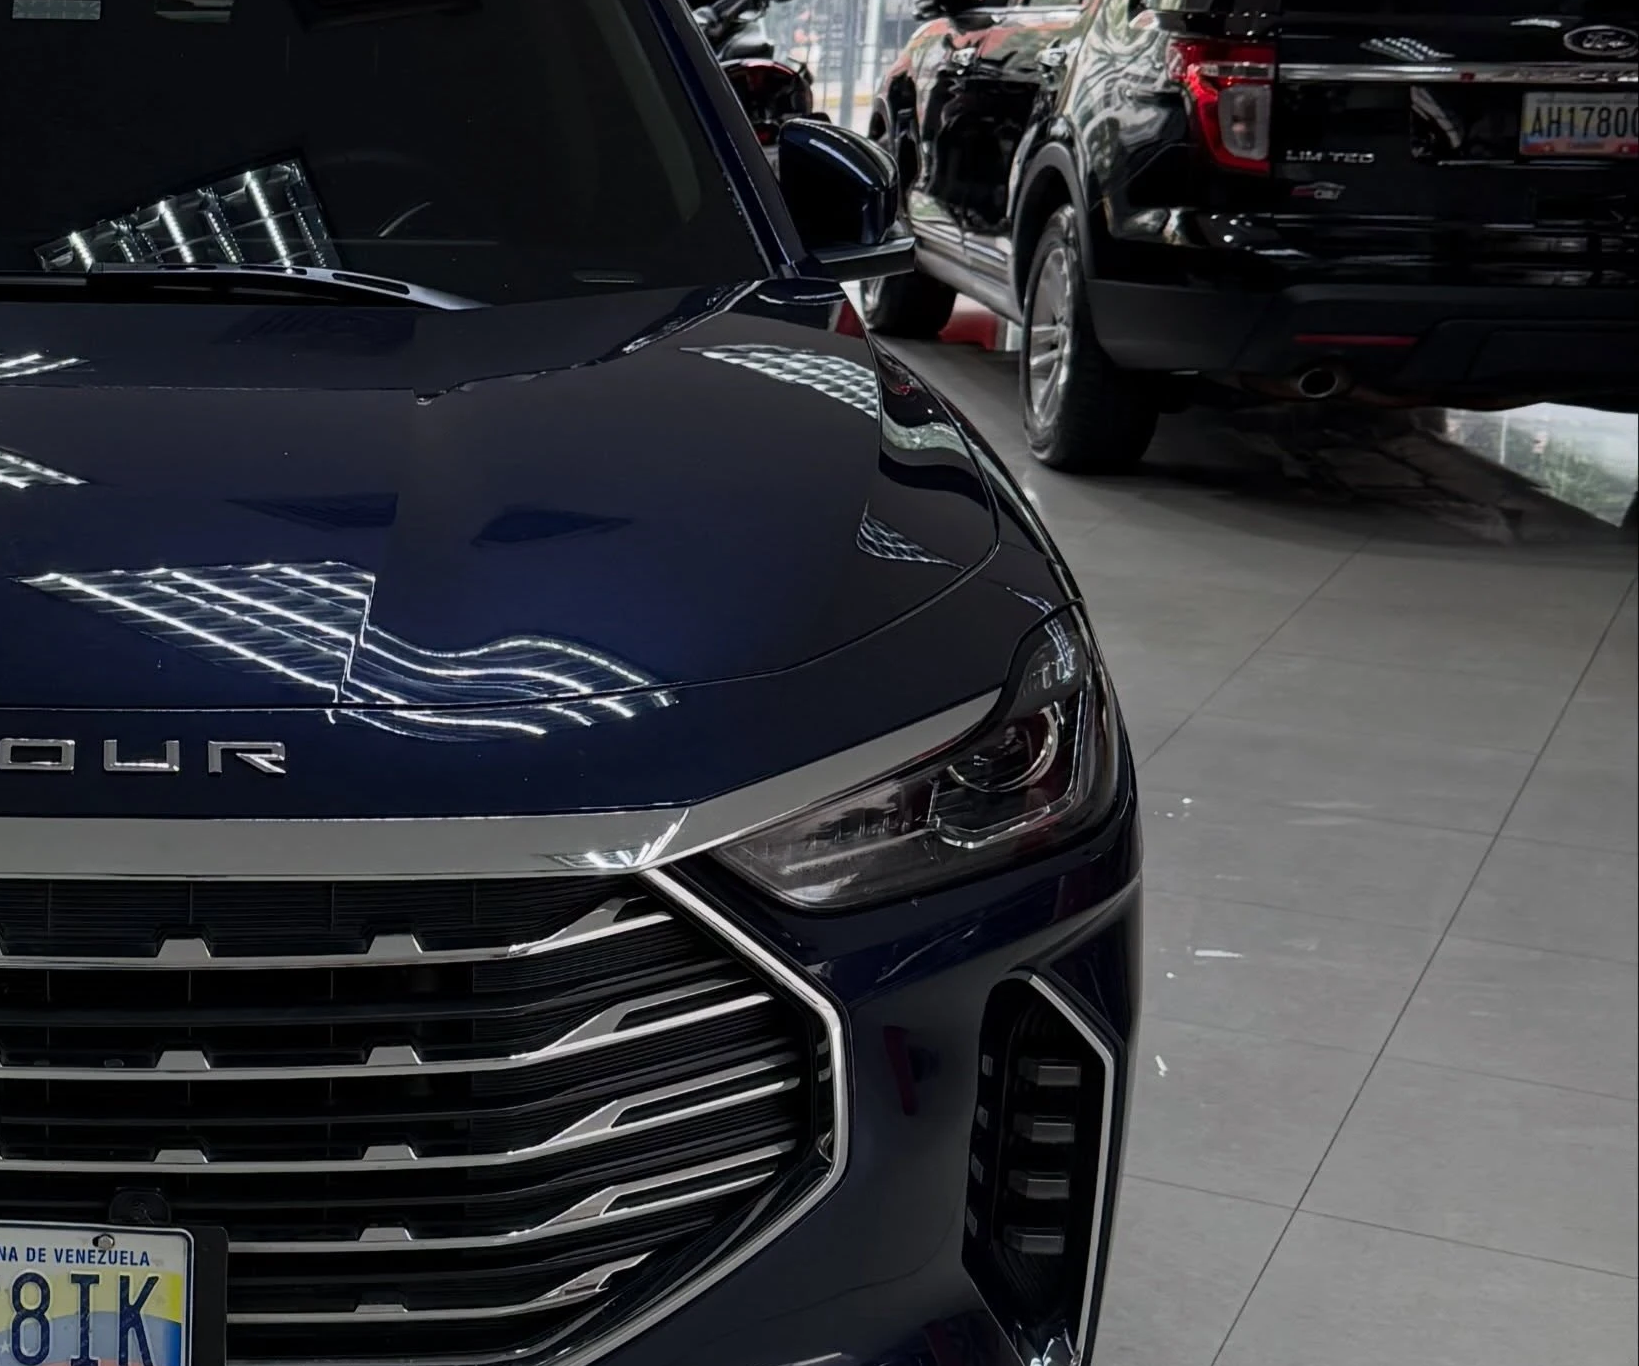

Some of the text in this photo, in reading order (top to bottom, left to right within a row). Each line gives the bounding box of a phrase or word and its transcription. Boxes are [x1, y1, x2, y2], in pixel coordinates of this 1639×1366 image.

[1286, 150, 1375, 163] LIMTED
[26, 1247, 47, 1263] DE
[54, 1248, 150, 1267] VENEZUELA
